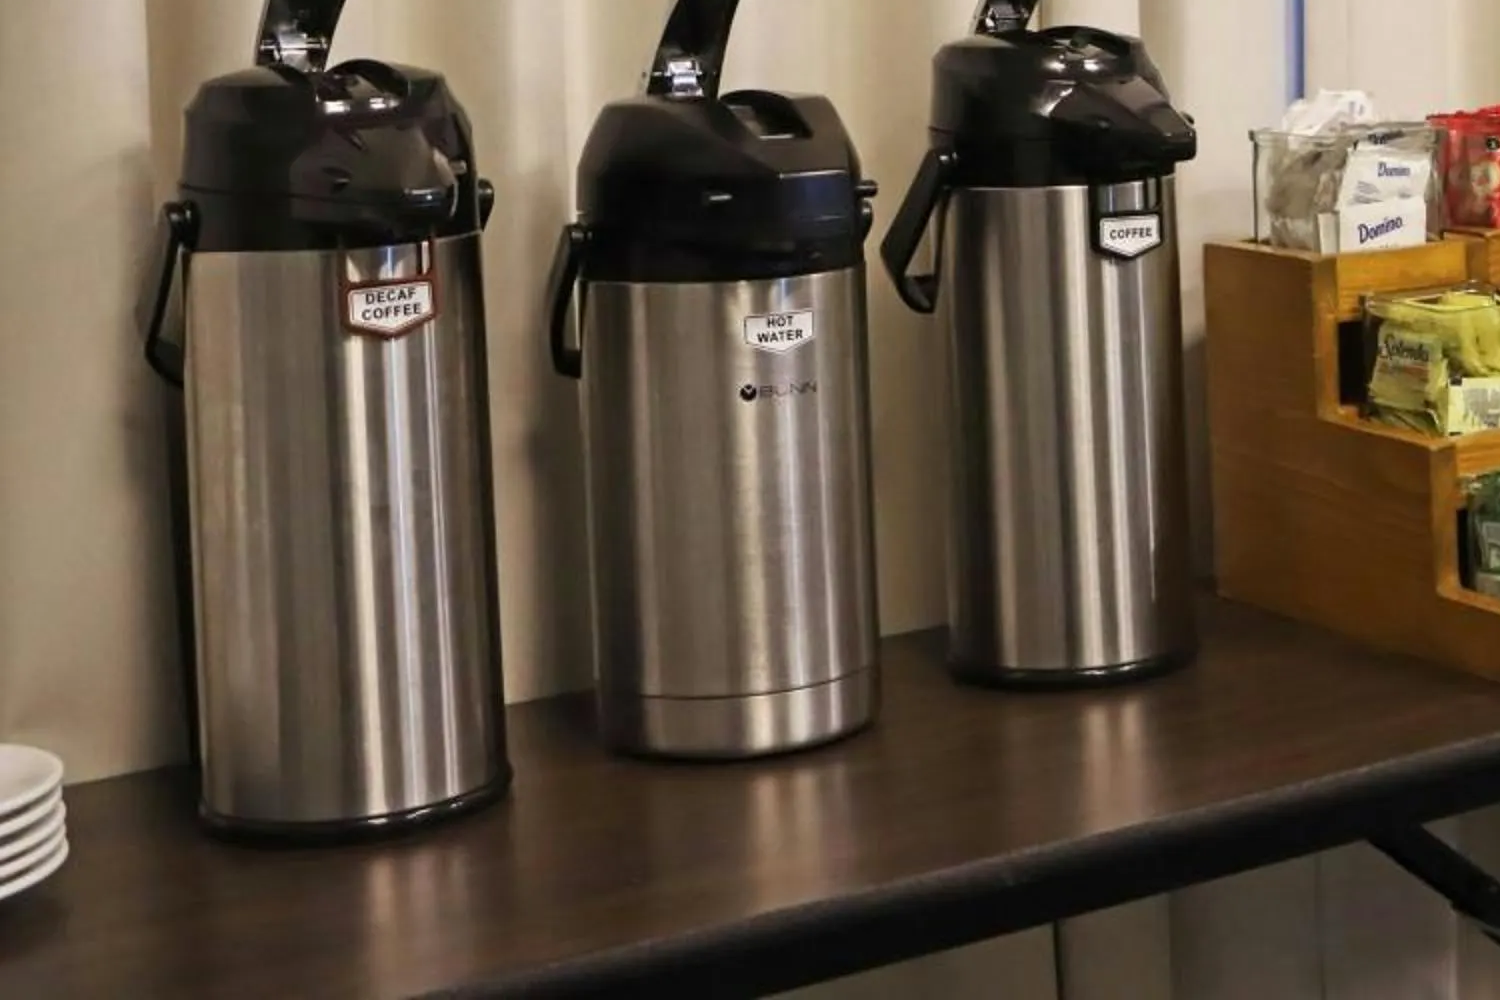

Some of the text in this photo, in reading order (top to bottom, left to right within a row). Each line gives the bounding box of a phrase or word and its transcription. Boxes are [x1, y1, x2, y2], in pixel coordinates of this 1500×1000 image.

[1109, 227, 1153, 239] COFFEE
[1357, 215, 1404, 244] Domino
[365, 287, 417, 305] DECAF
[361, 303, 421, 320] COFFEE
[767, 315, 794, 328] HOT
[757, 329, 804, 343] WATER
